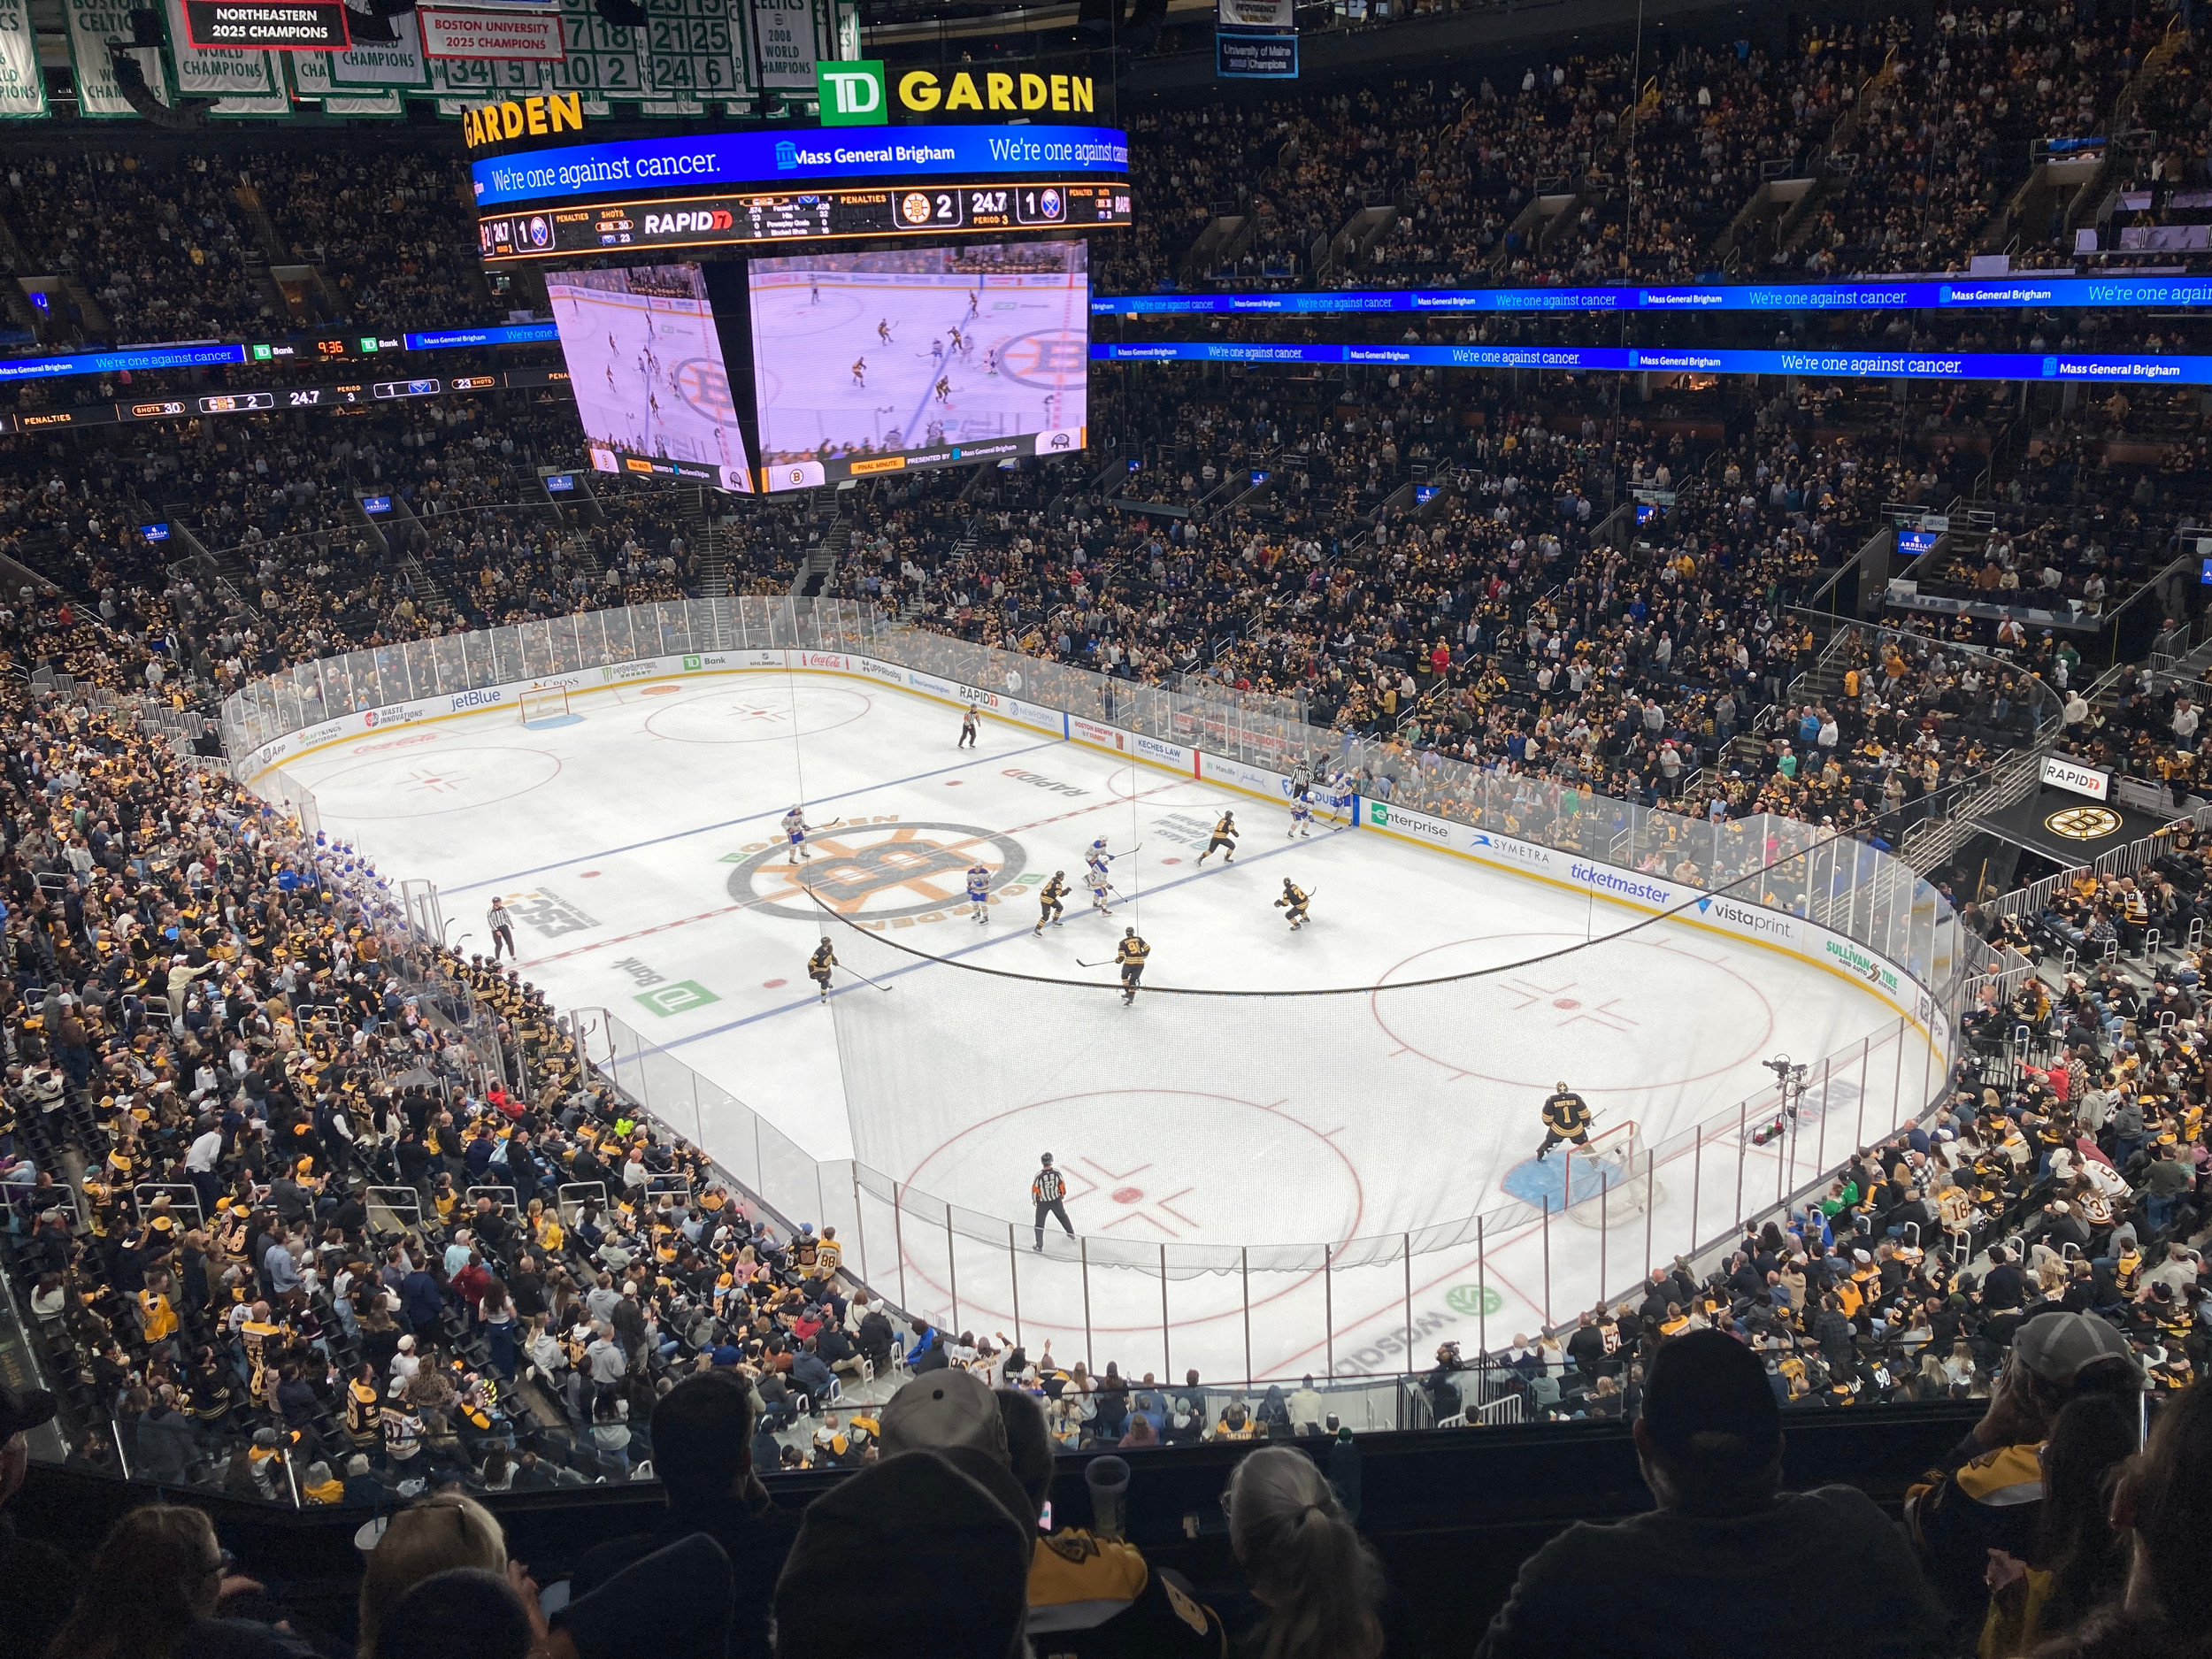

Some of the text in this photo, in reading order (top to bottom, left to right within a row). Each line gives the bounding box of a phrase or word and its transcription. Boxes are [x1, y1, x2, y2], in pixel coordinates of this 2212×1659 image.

[216, 9, 319, 22] NORTHEASTERN
[212, 25, 328, 39] 2025 CHAMPIONS
[434, 19, 549, 34] BOSTON UNIVERSITY
[566, 19, 585, 47] 7
[446, 36, 547, 50] 2025 CHAMPIONS
[654, 22, 686, 54] 21
[693, 22, 726, 53] 25
[769, 29, 792, 42] 2008
[765, 45, 800, 58] WORLD
[1224, 44, 1292, 58] University of Maine
[342, 51, 415, 68] CHAMPIONS
[183, 60, 262, 78] CHAMPIONS
[451, 59, 488, 83] 34
[509, 61, 524, 83] 5
[561, 57, 590, 85] 10
[608, 58, 627, 85] 2
[657, 58, 691, 86] 24
[709, 59, 722, 86] 6
[823, 70, 1094, 113] TD GARDEN
[464, 91, 583, 149] GARDEN
[795, 144, 956, 165] Mass General Brigham
[491, 165, 526, 192] We're
[526, 166, 556, 187] one
[558, 156, 632, 189] against
[635, 151, 721, 179] cancer.
[840, 193, 887, 204] PENALTIES
[972, 192, 1008, 213] 24.7
[1025, 191, 1035, 215] 1
[601, 209, 625, 219] SHOTS
[937, 195, 953, 219] 2
[557, 212, 589, 223] PENALTIES
[618, 221, 629, 230] 30
[644, 210, 733, 234] RAPID7
[973, 214, 1009, 225] PERIOD 3
[620, 233, 630, 243] 23
[1417, 296, 1476, 307] Mass General Brigham
[1495, 294, 1617, 308] We're one against cancer.
[1648, 293, 1722, 304] Mass General Brigham
[1748, 290, 1908, 308] We're one against cancer.
[1951, 288, 2051, 302] Mass General Brigham
[2088, 285, 2129, 302] We're
[2131, 288, 2169, 301] one
[424, 334, 486, 345] Mass General Brigham
[506, 329, 552, 341] We're one
[257, 346, 294, 357] TD Bank
[318, 341, 343, 353] 9:36
[364, 338, 398, 350] TD Bank
[96, 349, 234, 369] We're one against cancer.
[1453, 349, 1580, 365] We're one against cancer.
[1640, 356, 1721, 368] Mass General Brigham
[1781, 354, 1962, 374] We're one against cancer.
[0, 362, 73, 376] Mass General Brigham
[2060, 363, 2180, 378] Mass General Brigham
[387, 384, 395, 396] 1
[457, 378, 492, 389] 23 SHOTS
[247, 396, 257, 408] 2
[289, 390, 320, 406] 24.7
[348, 393, 355, 403] 3
[165, 403, 181, 414] 30
[24, 413, 71, 426] PENALTIES
[857, 463, 876, 472] FINAL
[877, 460, 899, 471] MINUTE
[907, 454, 941, 465] PRESENTED
[961, 449, 974, 458] Mass
[975, 446, 995, 457] General
[995, 444, 1018, 456] Brigham
[687, 657, 726, 668] TD Bank
[810, 653, 841, 668] Coca-Cola
[451, 689, 501, 712] jetBlue
[960, 686, 998, 707] RAPID7
[380, 706, 403, 717] WASTE
[380, 710, 423, 725] INNOVATIONS
[1019, 707, 1055, 723] NEWFORMA
[1074, 720, 1094, 731] BOSTON
[305, 733, 339, 747] SPORTSBOOK
[1138, 739, 1181, 758] KECHES LAW
[1216, 764, 1236, 776] Manulife
[2047, 765, 2101, 791] RAPID7
[1375, 808, 1448, 838] enterprise
[1494, 839, 1549, 864] SYMETRA
[1571, 863, 1671, 905] ticketmaster
[1716, 903, 1791, 939] vistaprint
[1826, 941, 1898, 990] SULLIVAN TIRE
[1839, 957, 1897, 996] AND AUTO SERVICE
[1563, 1106, 1571, 1124] 1
[1952, 1202, 1969, 1222] 18
[821, 1254, 836, 1268] 88
[1875, 1367, 1892, 1389] 90
